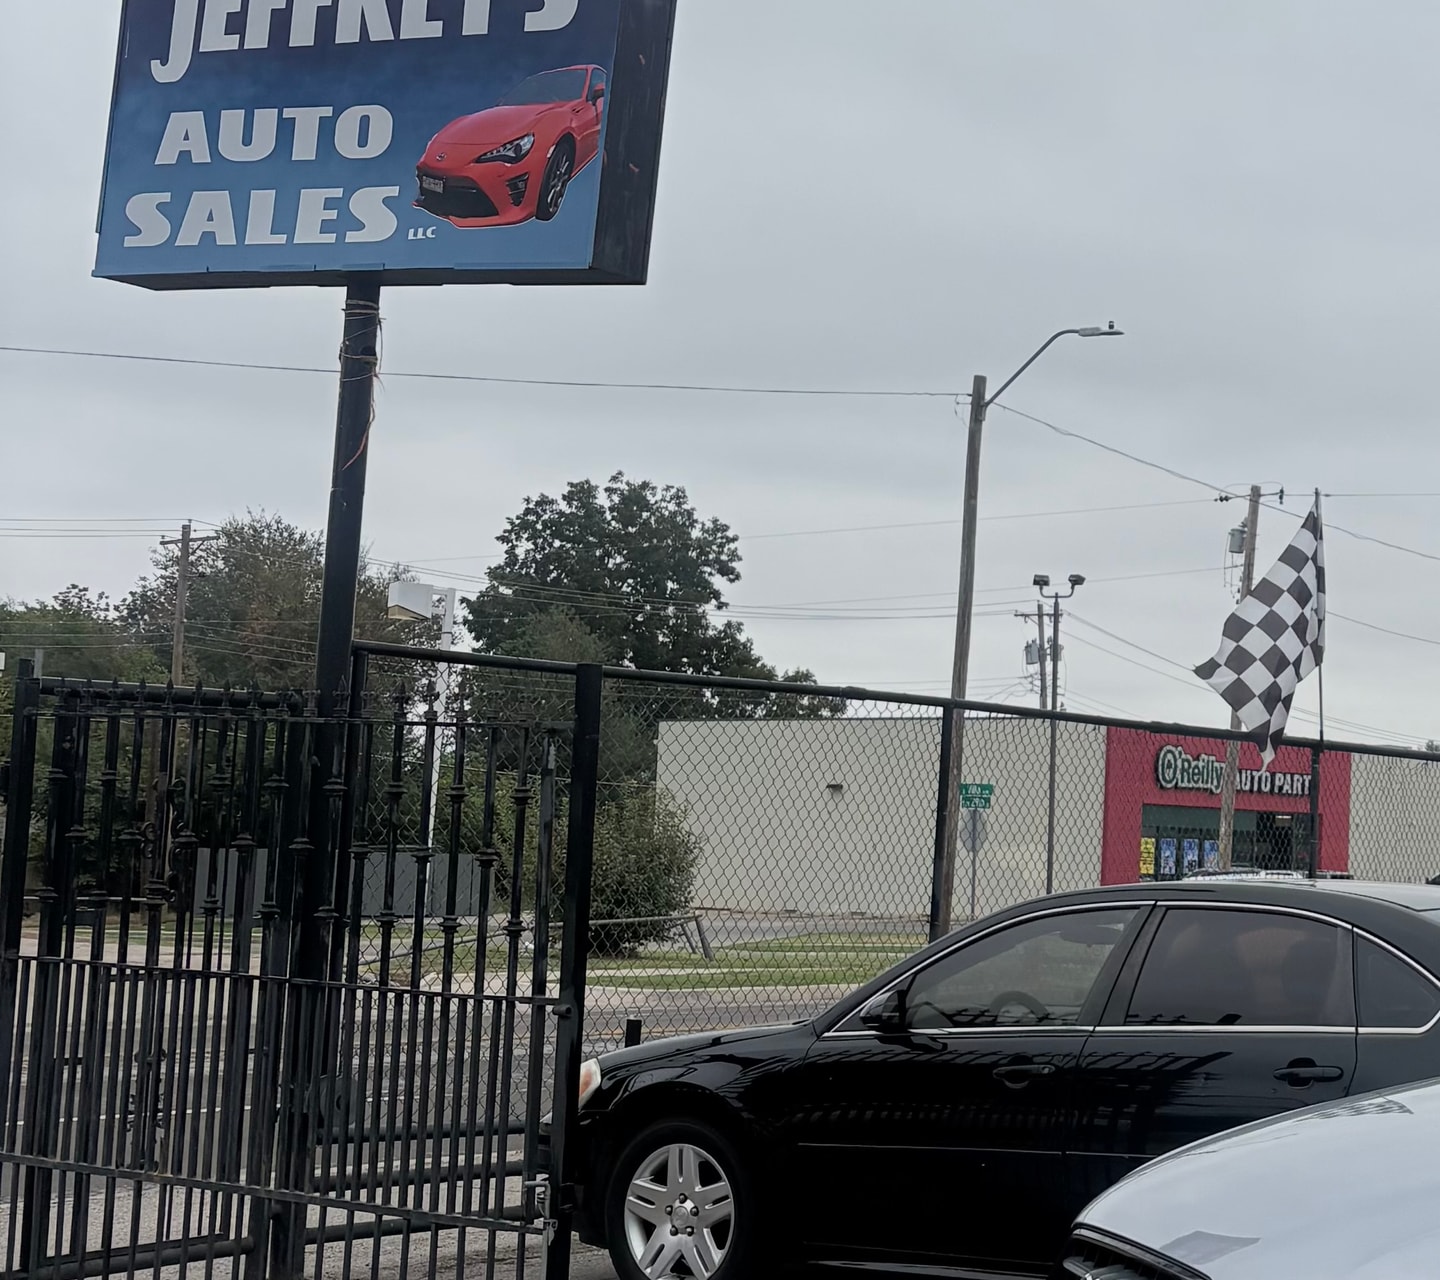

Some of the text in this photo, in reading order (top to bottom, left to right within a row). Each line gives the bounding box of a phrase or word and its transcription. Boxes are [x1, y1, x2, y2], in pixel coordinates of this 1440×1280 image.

[154, 104, 394, 166] AUTO
[122, 185, 400, 248] SALES
[407, 225, 437, 241] LLC
[1158, 744, 1226, 794] O'Reilly
[1274, 772, 1312, 795] PART
